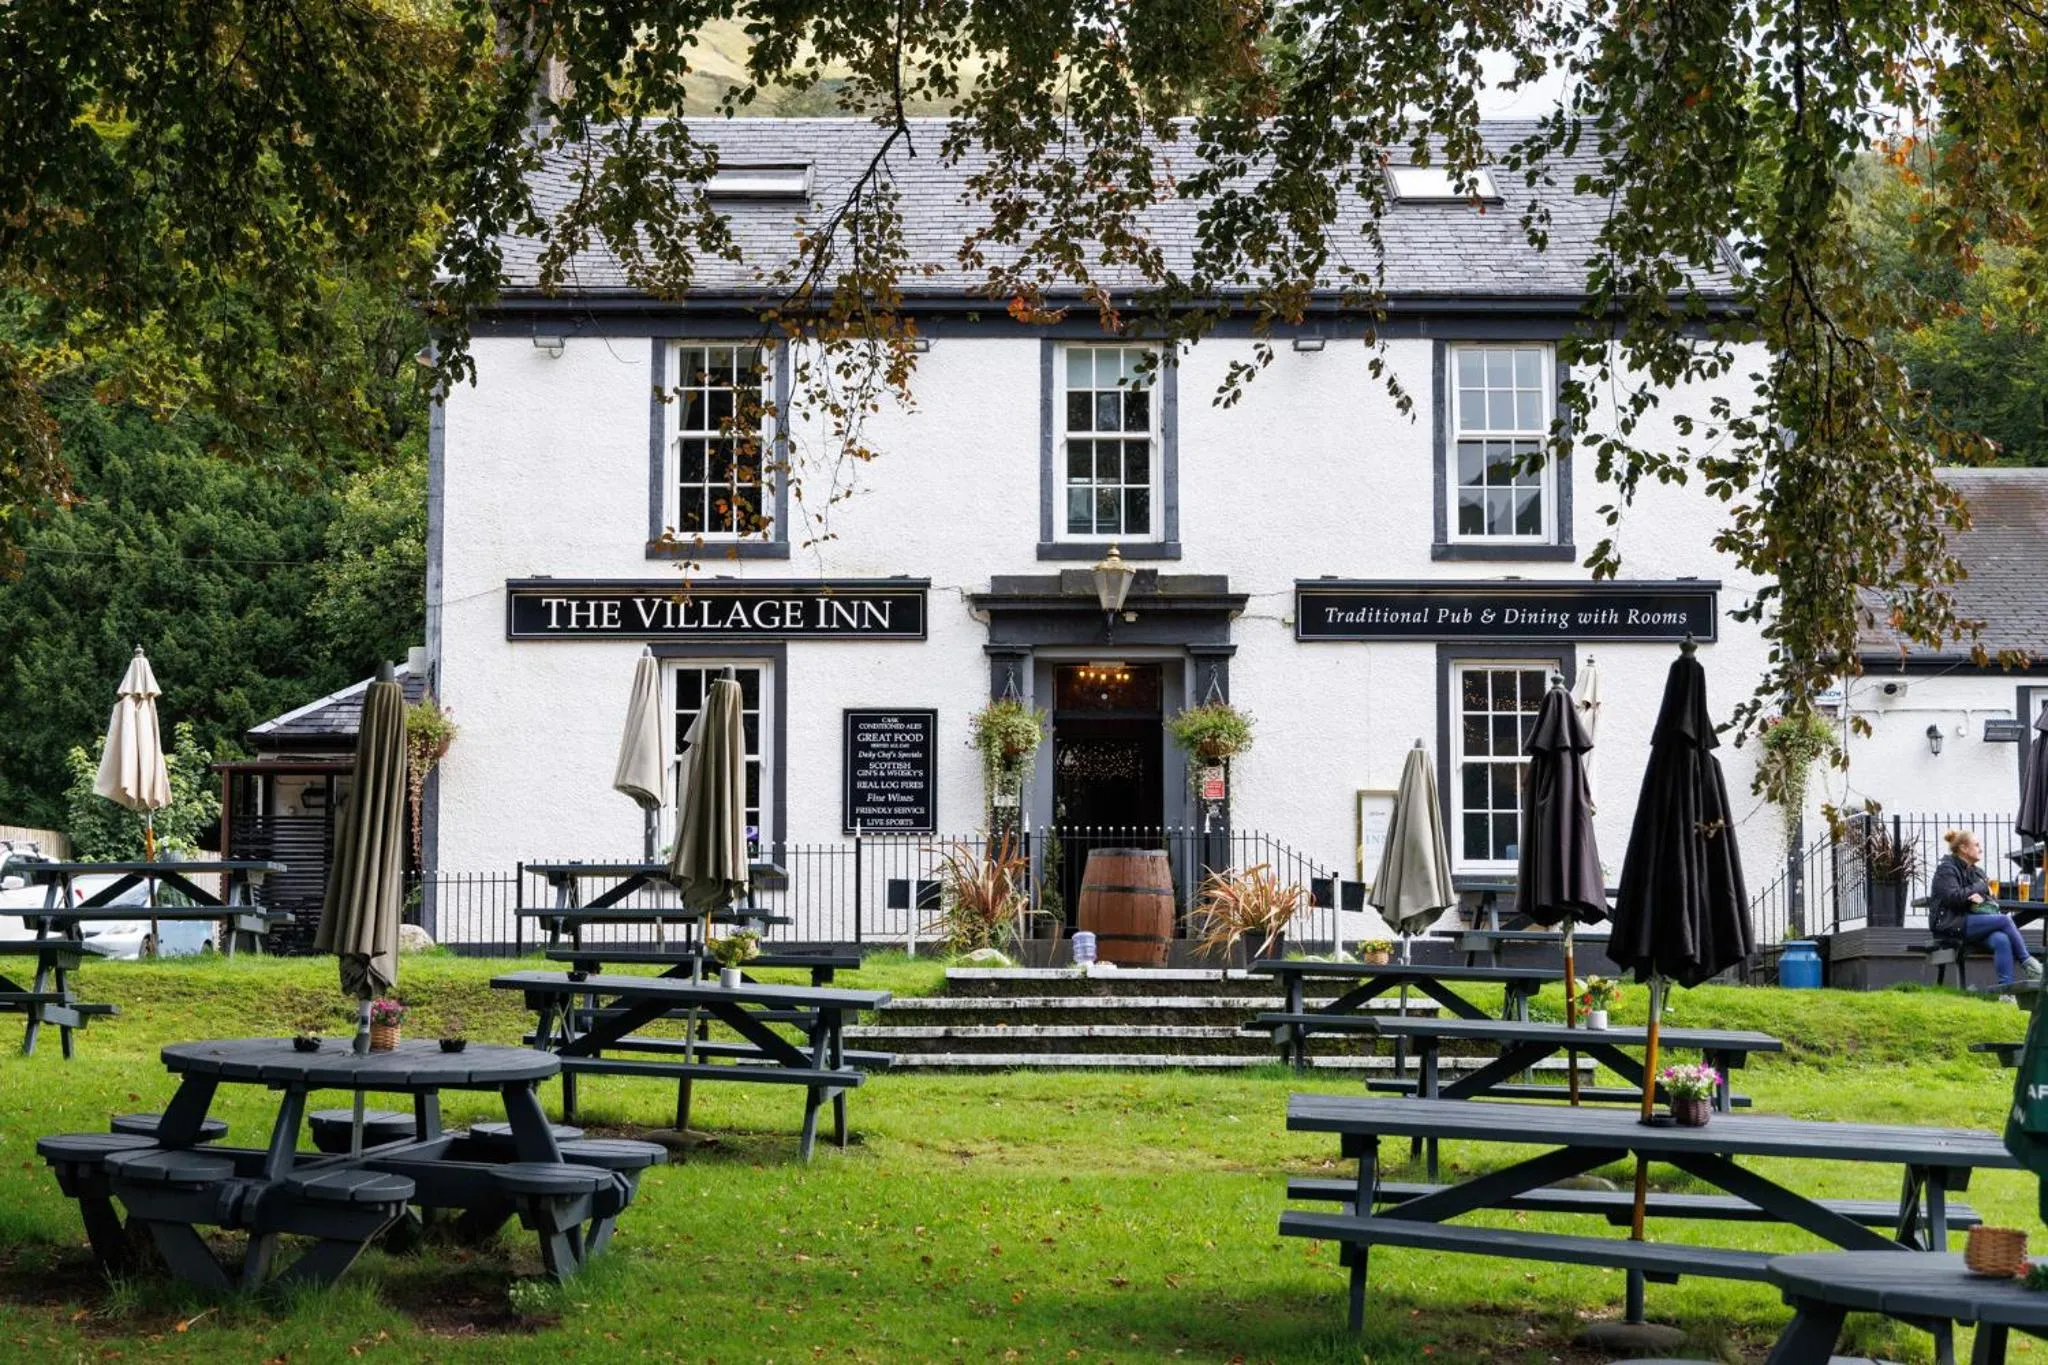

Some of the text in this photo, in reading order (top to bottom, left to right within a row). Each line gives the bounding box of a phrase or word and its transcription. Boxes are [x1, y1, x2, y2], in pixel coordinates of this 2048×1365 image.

[542, 597, 892, 629] THE VILLAGE INN
[1324, 607, 1688, 629] Traditional Pub & Dining with Rooms
[857, 733, 924, 742] GREAT FOOD
[858, 751, 876, 760] Daily
[897, 751, 923, 760] Specials
[869, 762, 911, 770] SCOTTISH
[879, 769, 885, 777] &
[856, 781, 924, 789] REAL LOG FIRES
[866, 793, 914, 802] Fine Wines
[855, 806, 925, 814] FRIENDLY SERVICE
[866, 818, 914, 826] LIVE SPORTS
